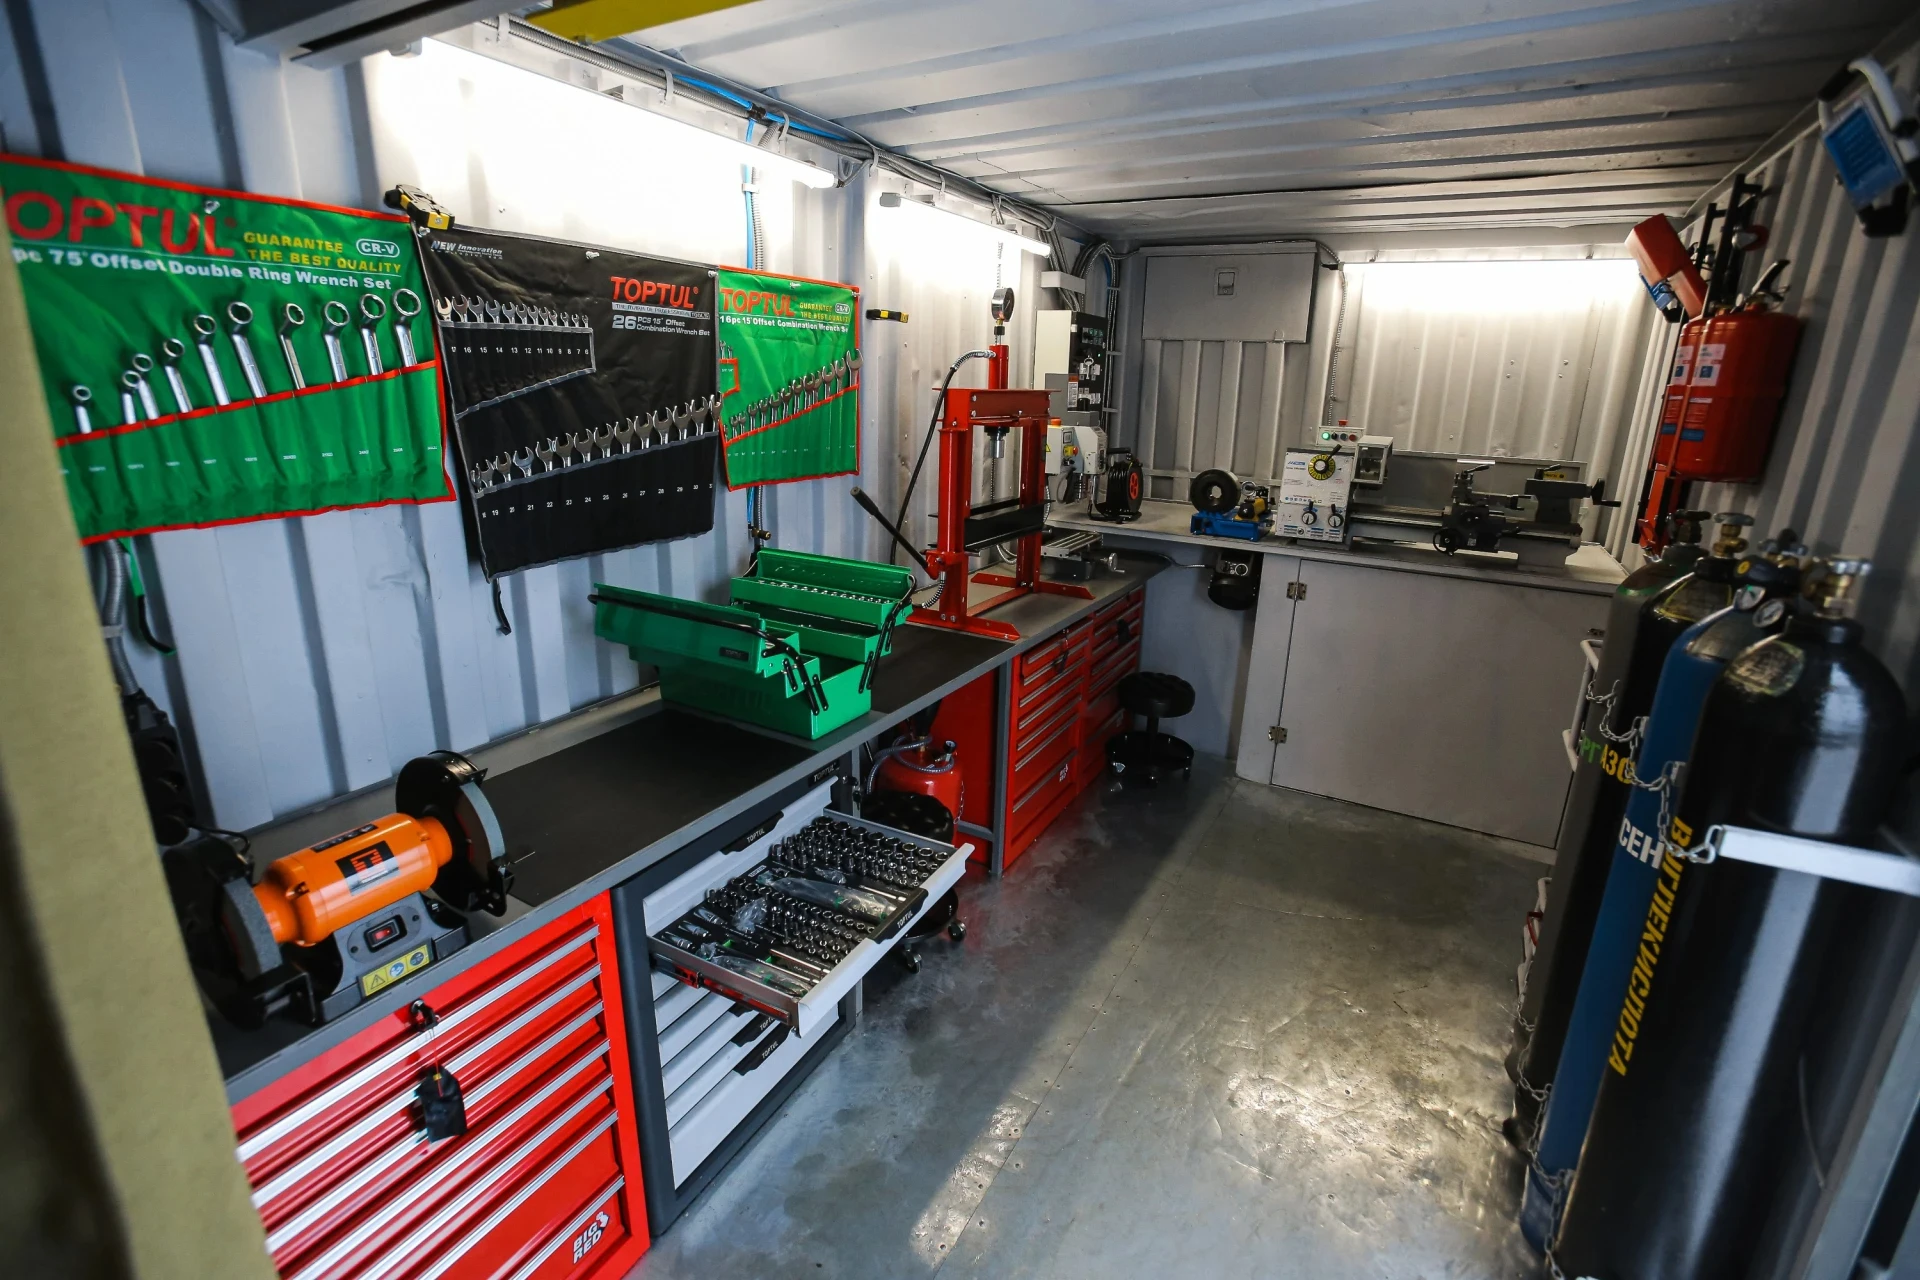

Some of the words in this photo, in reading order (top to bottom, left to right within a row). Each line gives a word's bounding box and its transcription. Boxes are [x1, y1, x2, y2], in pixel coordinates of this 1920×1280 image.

[0, 188, 236, 257] OPTUL
[243, 232, 343, 253] GUARANTEE
[361, 242, 395, 255] CR-V
[431, 240, 456, 251] NEW
[457, 243, 503, 255] Innovation
[247, 249, 283, 262] THE
[290, 252, 331, 267] BEST
[337, 257, 402, 273] QUALITY
[90, 253, 167, 271] Offset
[169, 260, 243, 278] Double
[248, 267, 292, 284] Ring
[295, 270, 358, 288] Wrench
[363, 277, 392, 289] Set
[610, 276, 694, 308] TOPTUL
[719, 287, 795, 317] TOPTUL
[612, 314, 637, 330] 26
[637, 316, 651, 324] PCS
[665, 318, 685, 327] Offset
[719, 315, 741, 325] 16pc
[752, 318, 776, 327] Offset
[777, 320, 818, 330] Combination
[818, 323, 841, 332] Wrench
[800, 311, 812, 319] THE
[637, 323, 676, 333] Combination
[675, 327, 698, 336] Wrench
[464, 346, 472, 354] 16
[480, 346, 488, 354] 15
[746, 828, 766, 844] TOPTUL
[896, 910, 914, 929] TOPTUL
[761, 1041, 779, 1059] TOPTUL
[573, 1221, 598, 1252] BIG
[573, 1229, 602, 1265] RED
